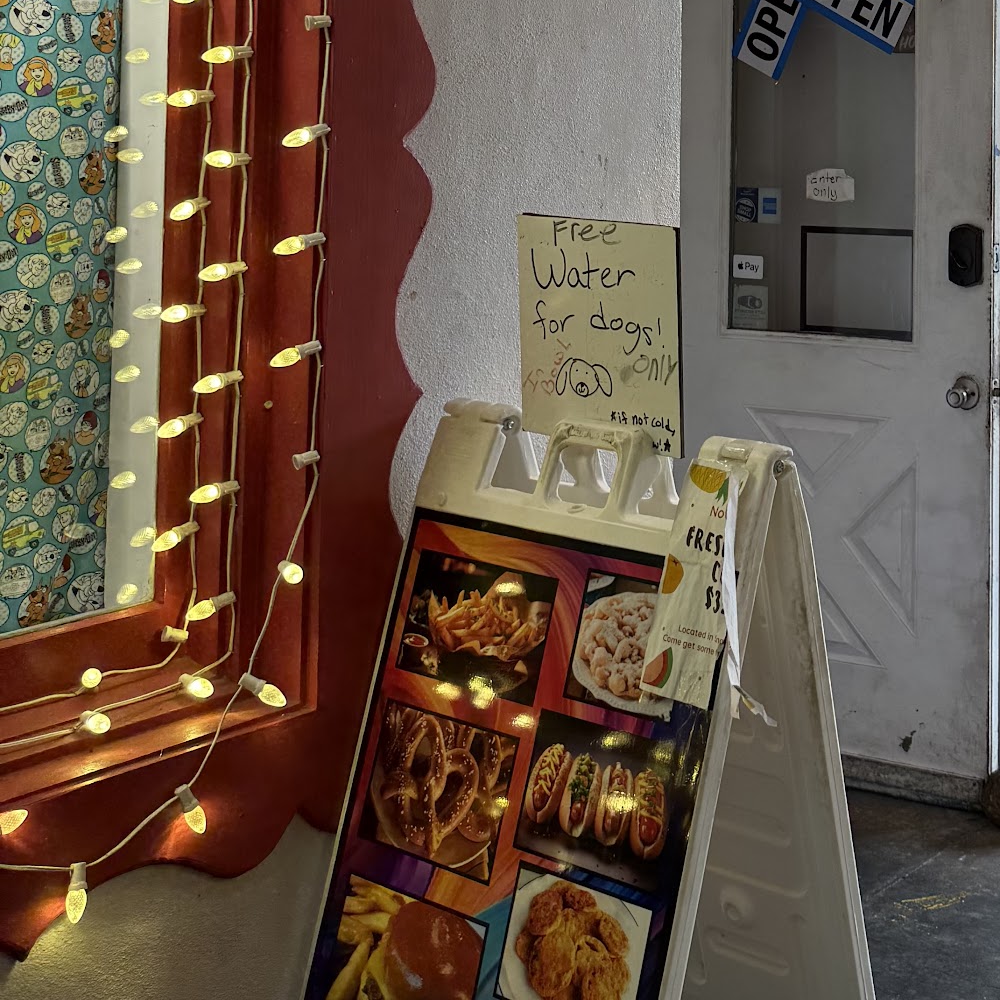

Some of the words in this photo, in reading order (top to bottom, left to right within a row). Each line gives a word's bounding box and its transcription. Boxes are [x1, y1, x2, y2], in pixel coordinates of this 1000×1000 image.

[553, 219, 621, 247] Free
[531, 248, 636, 290] Water
[745, 262, 759, 273] Pay
[532, 300, 575, 339] for
[590, 301, 666, 355] dogs!
[632, 412, 649, 425] not
[678, 624, 707, 640] Located
[707, 632, 714, 641] in
[662, 633, 682, 646] Come
[682, 641, 696, 650] get
[696, 644, 714, 656] some
